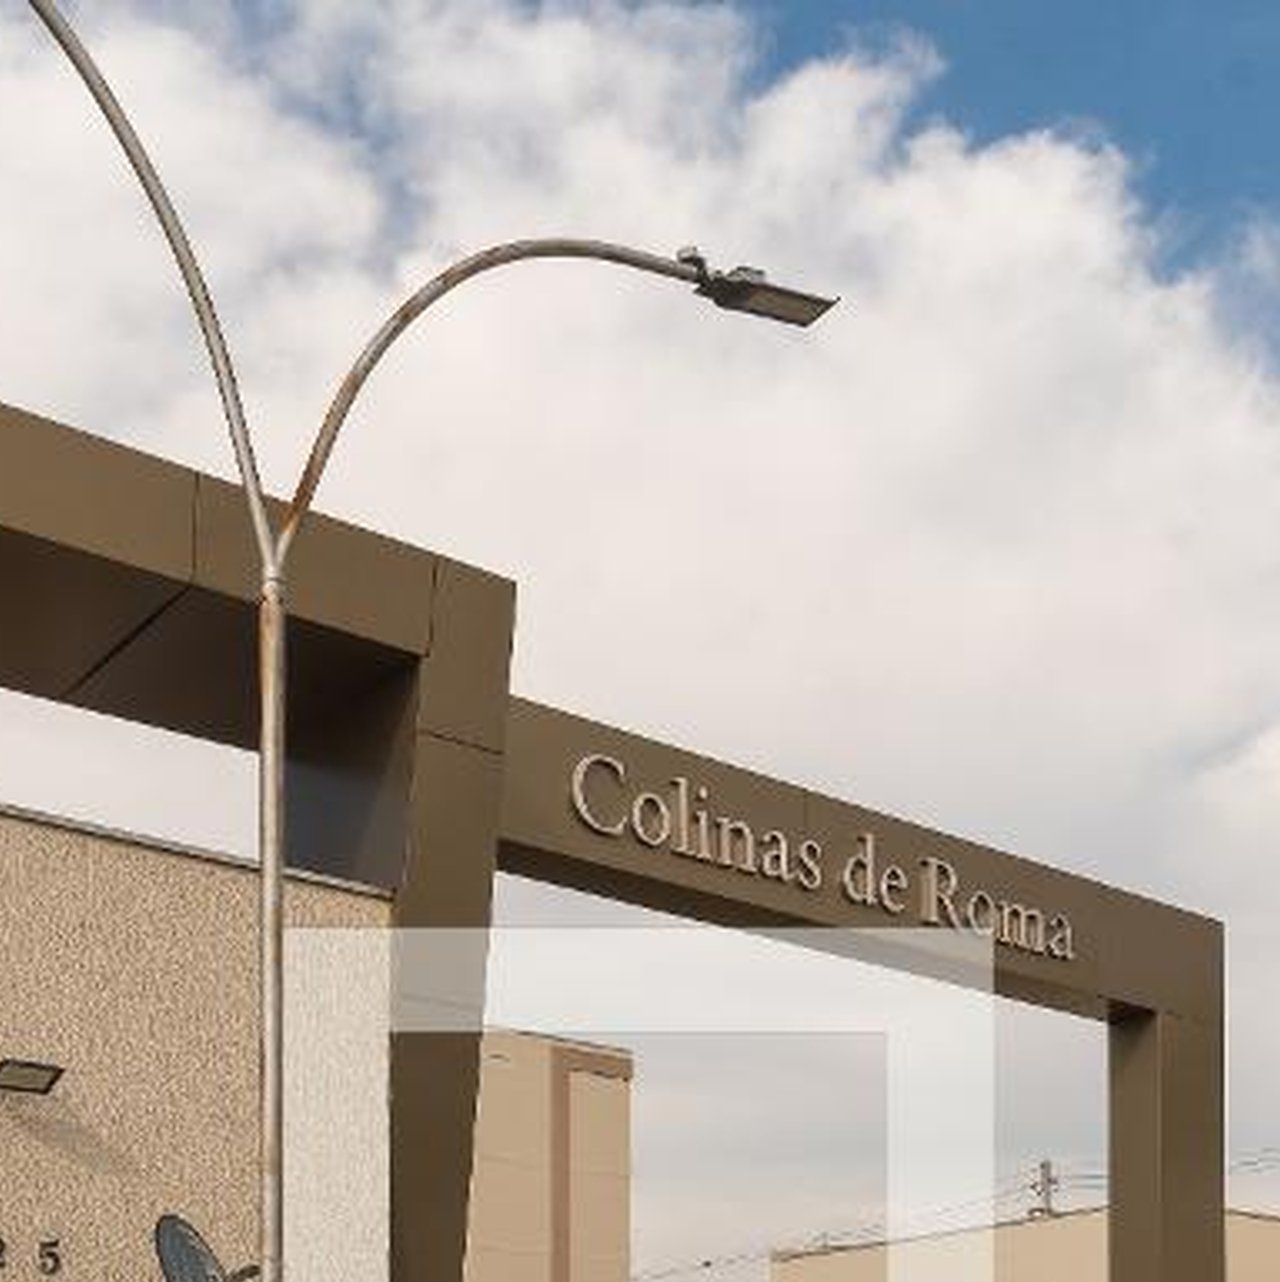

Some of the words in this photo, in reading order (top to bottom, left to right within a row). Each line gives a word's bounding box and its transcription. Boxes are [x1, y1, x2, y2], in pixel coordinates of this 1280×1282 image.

[571, 753, 822, 889] Colinas
[842, 832, 909, 912] de
[921, 856, 1075, 960] Roma
